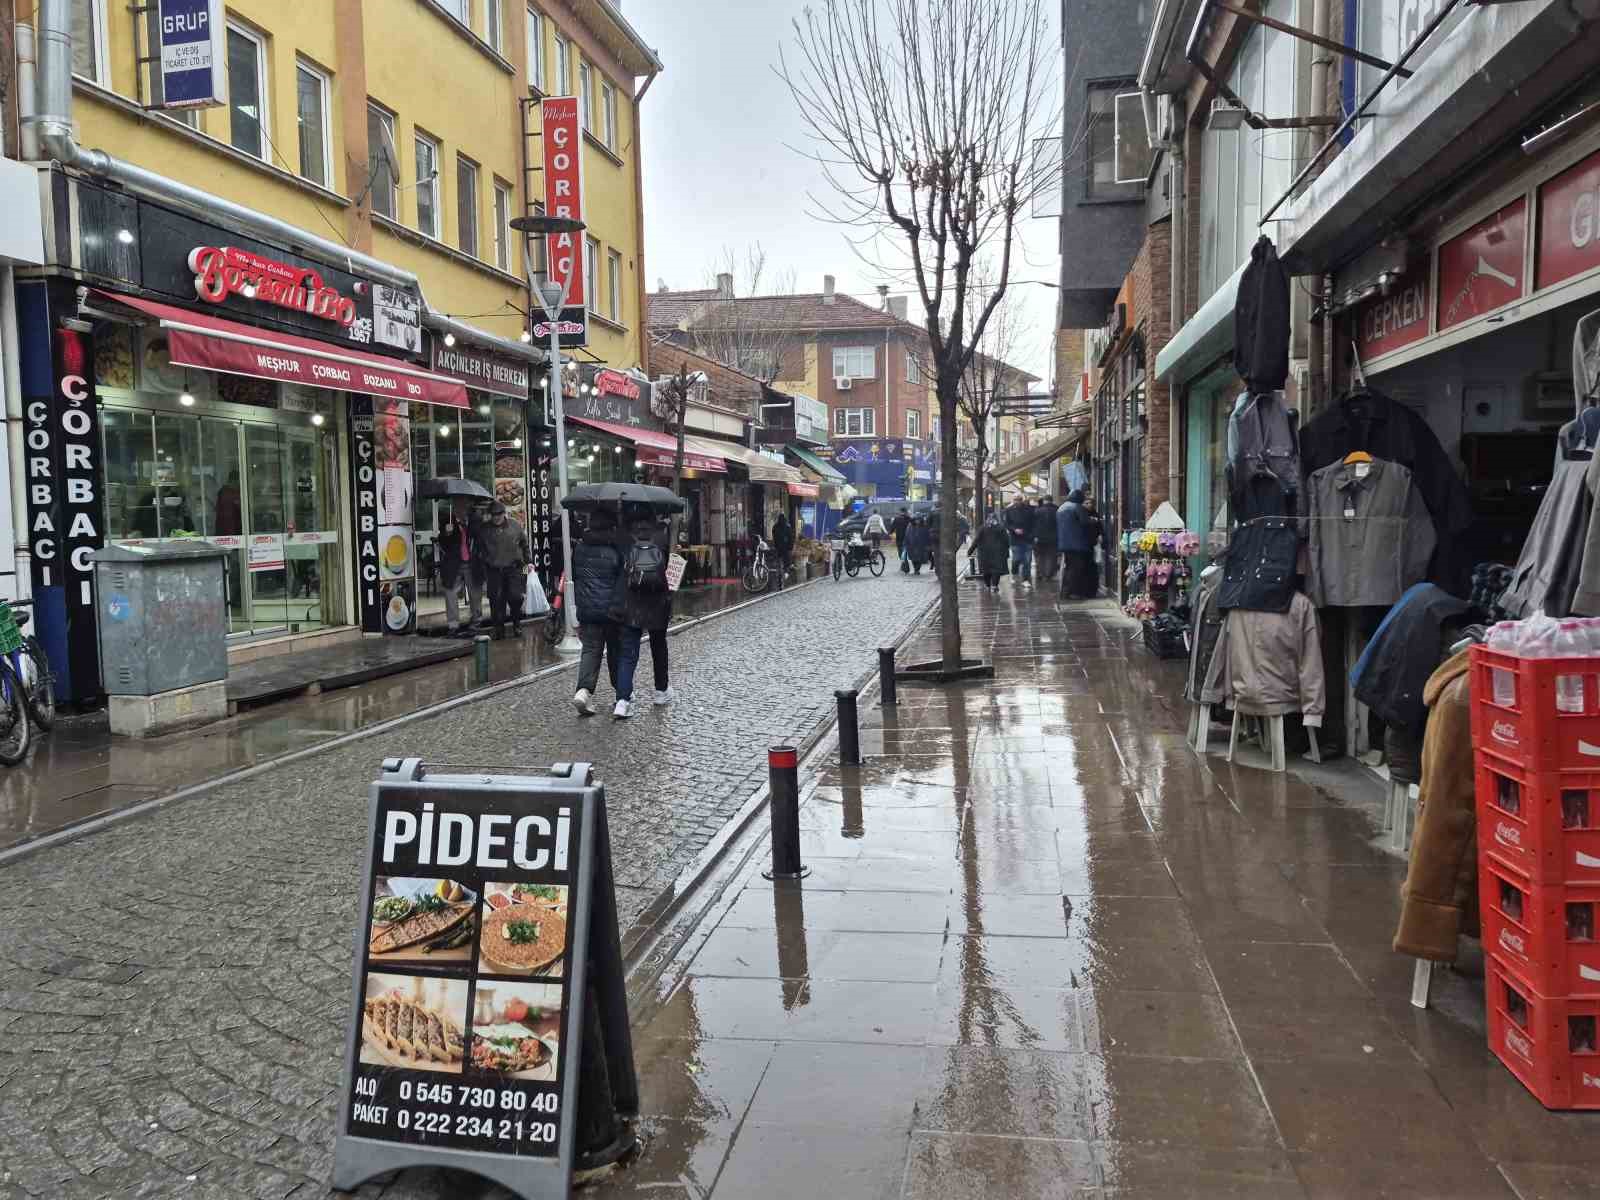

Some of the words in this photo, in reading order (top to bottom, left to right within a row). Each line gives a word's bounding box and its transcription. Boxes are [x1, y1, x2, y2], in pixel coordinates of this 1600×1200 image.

[163, 11, 208, 34] GRUP
[553, 126, 573, 299] ÇORBAC
[348, 327, 371, 344] 1957
[257, 354, 300, 374] MEŞHUR
[312, 364, 350, 382] ÇORBACI
[363, 373, 398, 391] BOZANLI
[438, 350, 481, 377] AKÇİNLER
[27, 400, 56, 587] ÇORBACI
[61, 374, 98, 606] ÇORBACI
[358, 441, 378, 606] ÇORBACI
[531, 469, 540, 567] ÇORBAC
[382, 801, 571, 871] PİDECİ
[355, 1076, 377, 1097] ALO
[399, 1081, 411, 1100] 0
[416, 1081, 453, 1105] 545
[458, 1085, 496, 1108] 730
[500, 1089, 526, 1110] 80
[530, 1091, 558, 1113] 40
[352, 1103, 389, 1126] PAKET
[397, 1111, 408, 1129] 0
[413, 1112, 450, 1134] 222
[455, 1115, 494, 1138] 234
[498, 1118, 523, 1140] 21
[529, 1121, 556, 1143] 20
